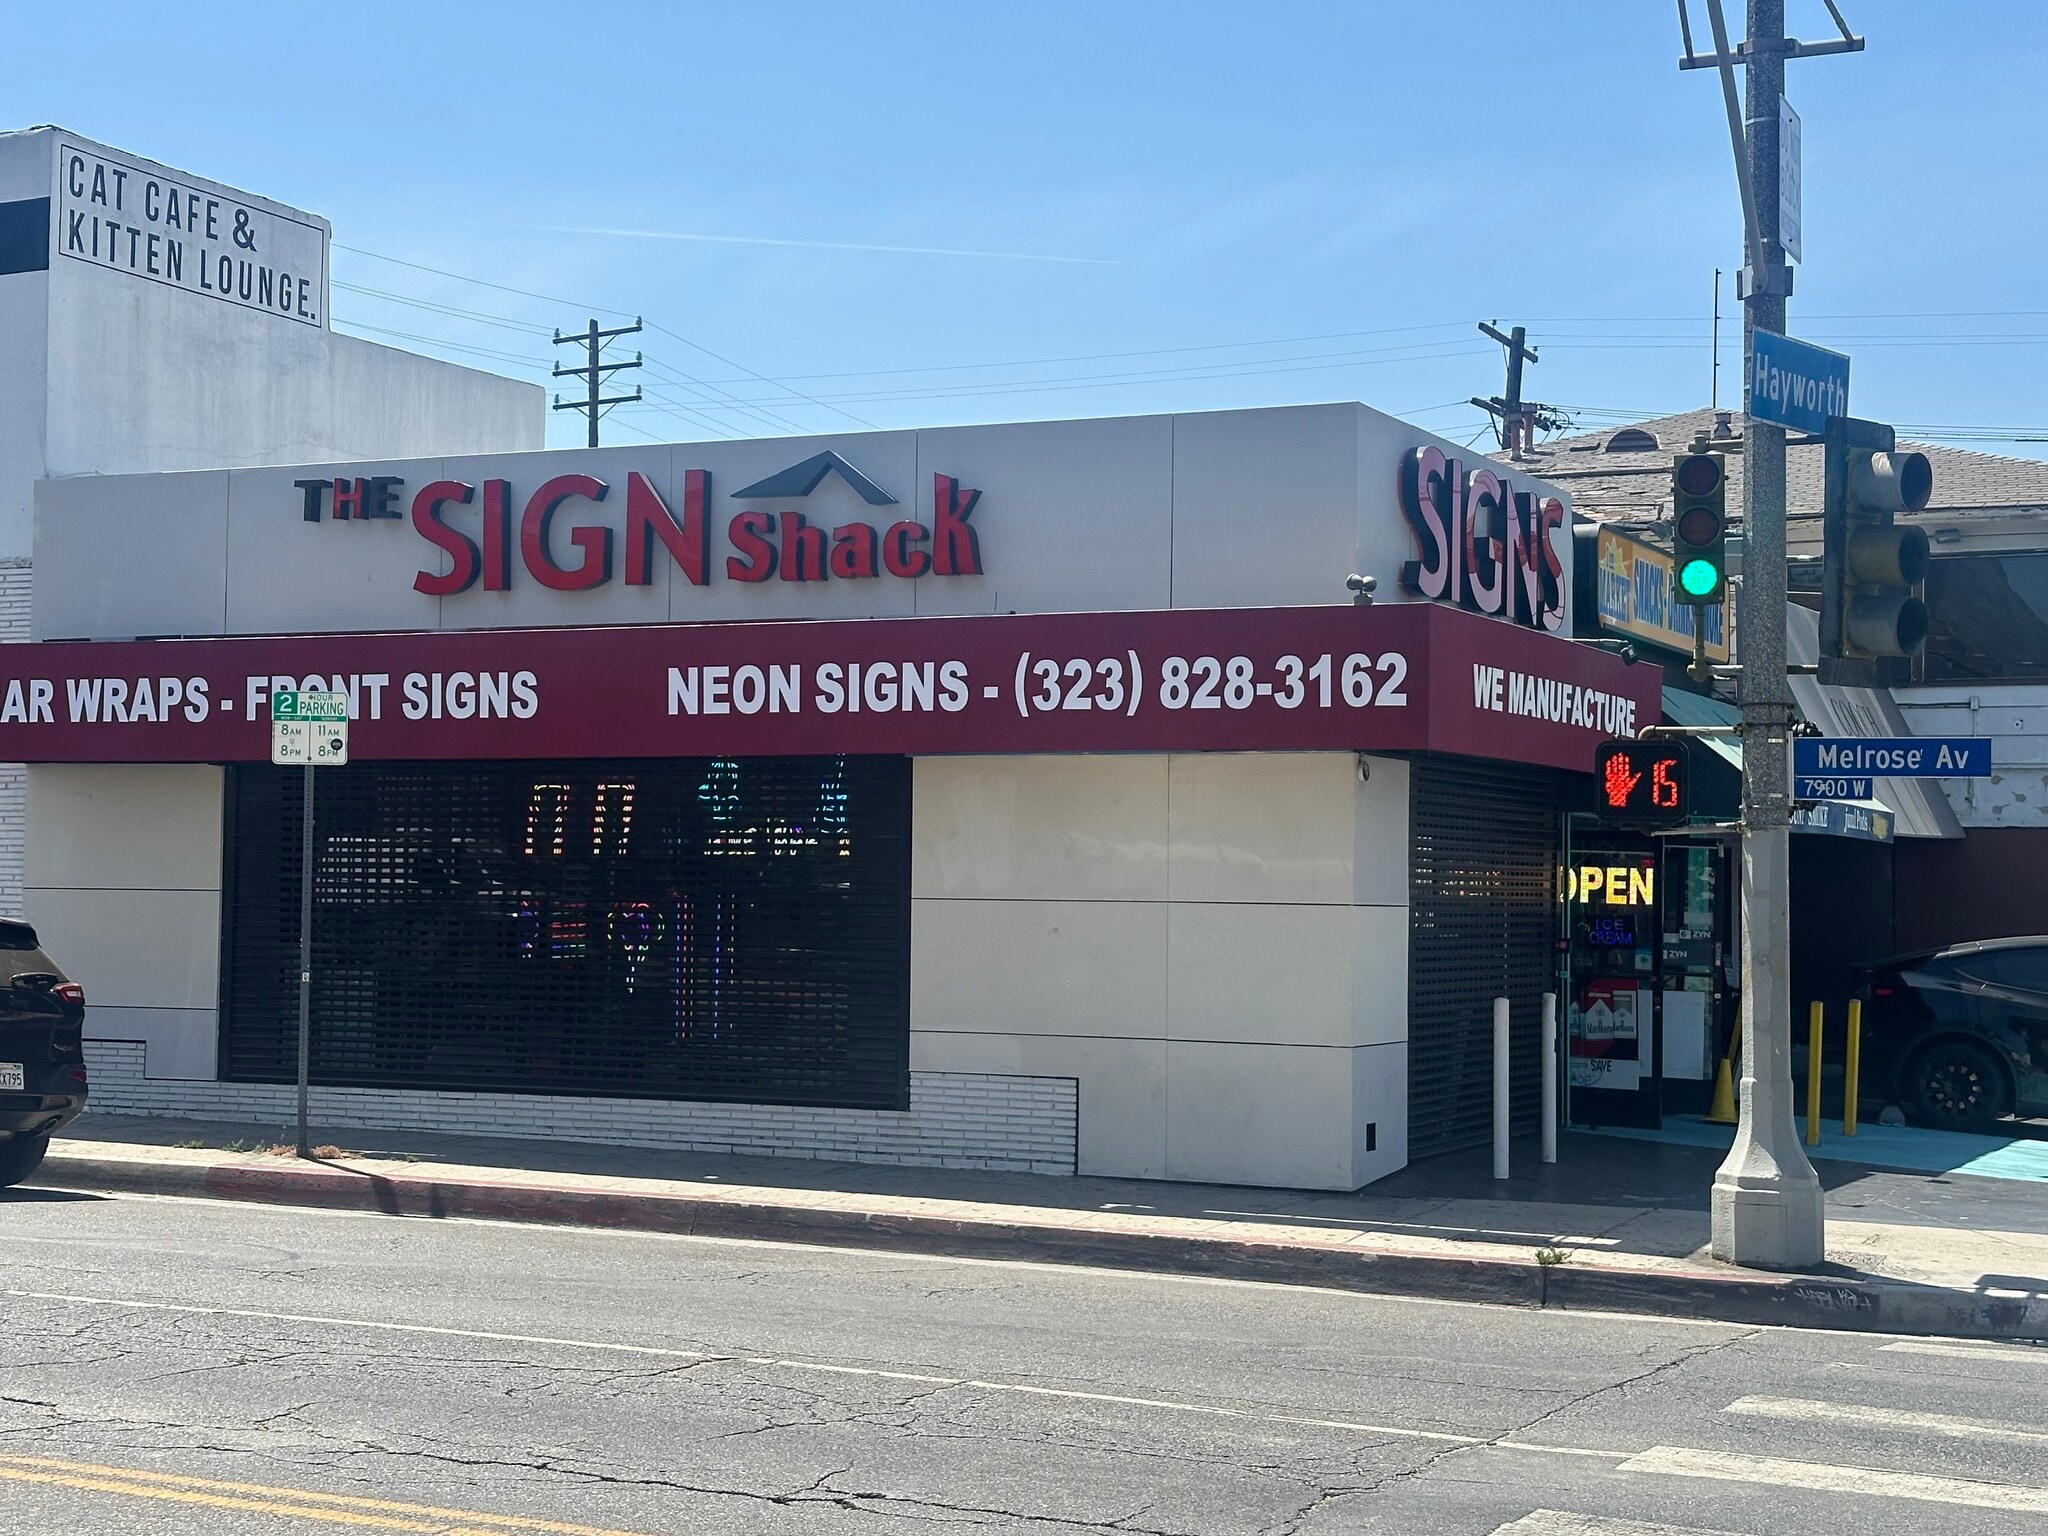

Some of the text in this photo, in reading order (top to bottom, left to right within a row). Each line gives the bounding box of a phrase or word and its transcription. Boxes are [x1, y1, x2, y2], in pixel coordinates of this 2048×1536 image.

[69, 155, 258, 252] CAT CAFE &
[69, 209, 316, 319] KITTEN LOUNGE.
[1755, 352, 1845, 417] Hayworth
[293, 468, 984, 596] THE SIGN shack
[1400, 445, 1566, 631] SIGNS
[66, 677, 209, 723] WRAPS
[402, 670, 539, 721] SIGNS
[667, 664, 801, 716] NEON
[814, 660, 969, 713] SIGNS
[1013, 649, 1143, 717] (323)
[1158, 652, 1408, 711] 828-3162
[279, 694, 292, 712] 2
[299, 702, 344, 715] PARKING
[1473, 663, 1636, 738] WE MANUFACTURE
[1818, 744, 1969, 769] Melrose Av
[1804, 779, 1866, 797] 7900 W
[1560, 866, 1654, 905] OPEN
[1595, 919, 1624, 931] ICE
[1692, 930, 1711, 939] ZYN
[1589, 931, 1633, 945] CREAM
[1668, 950, 1688, 958] ZYN
[1590, 1060, 1612, 1072] SAVE
